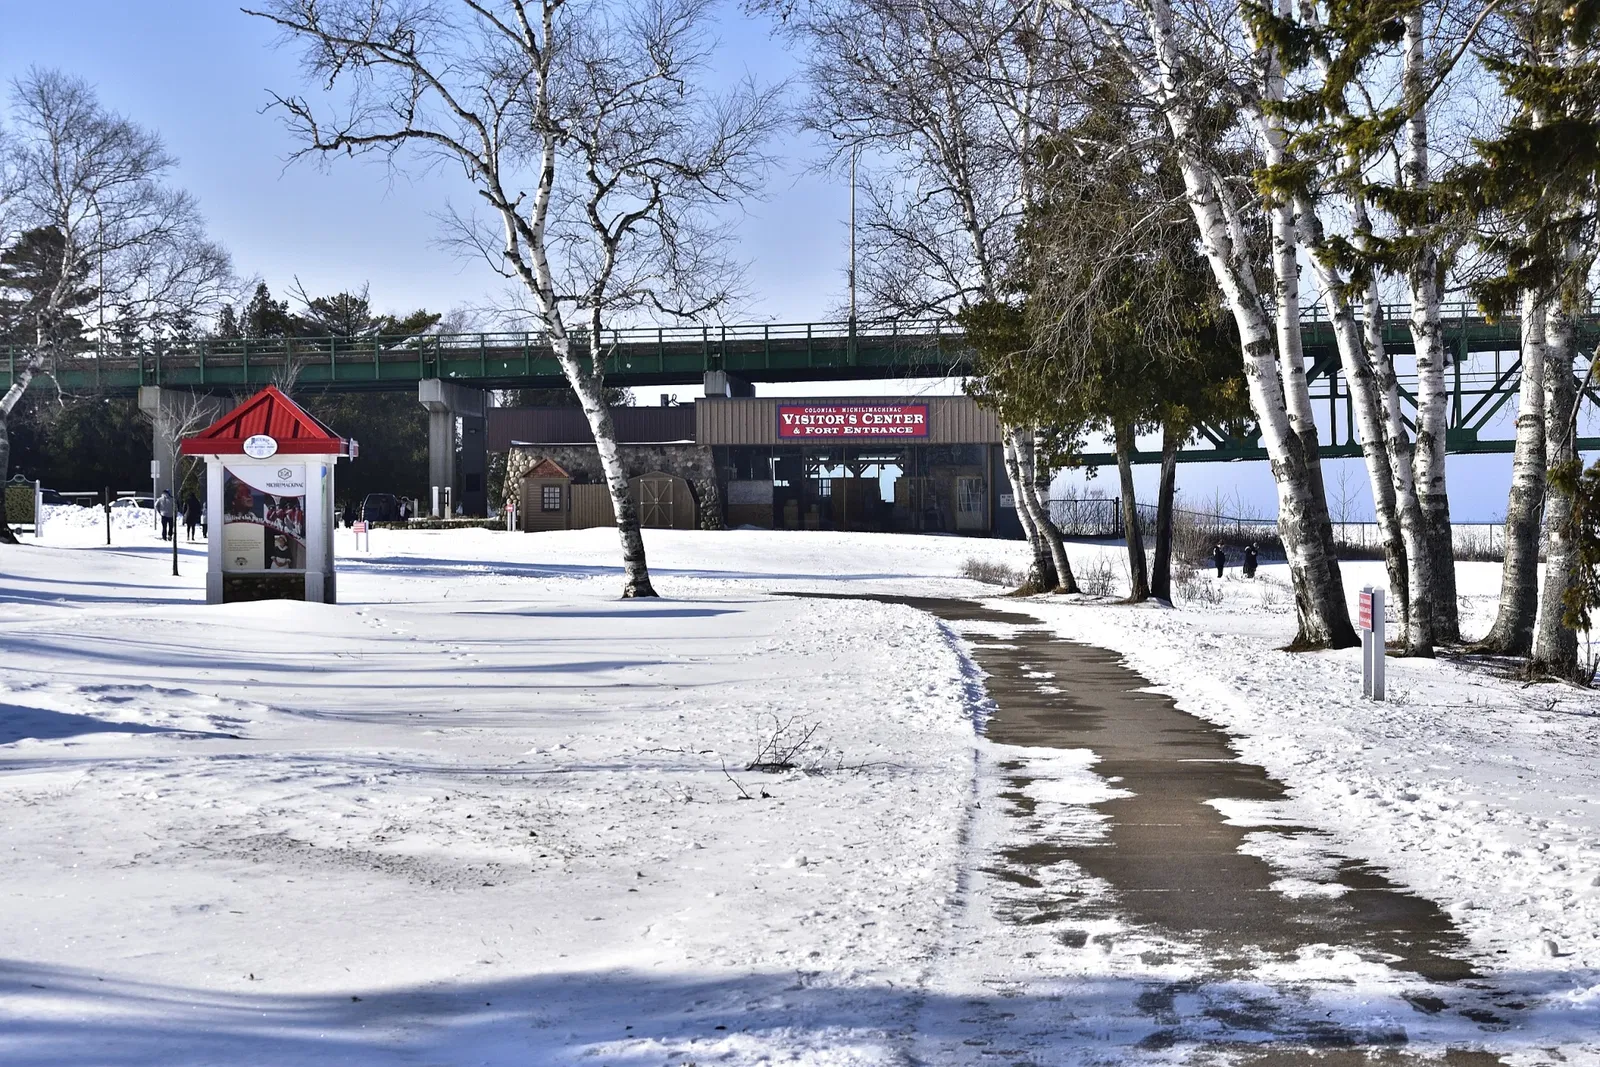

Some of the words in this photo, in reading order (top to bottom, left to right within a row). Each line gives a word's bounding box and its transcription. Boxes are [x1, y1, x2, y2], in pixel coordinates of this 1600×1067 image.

[782, 413, 858, 425] VISITOR'S
[862, 412, 924, 425] CENTER
[793, 427, 801, 435] &
[805, 426, 839, 434] FORT
[843, 426, 914, 434] ENTRANCE
